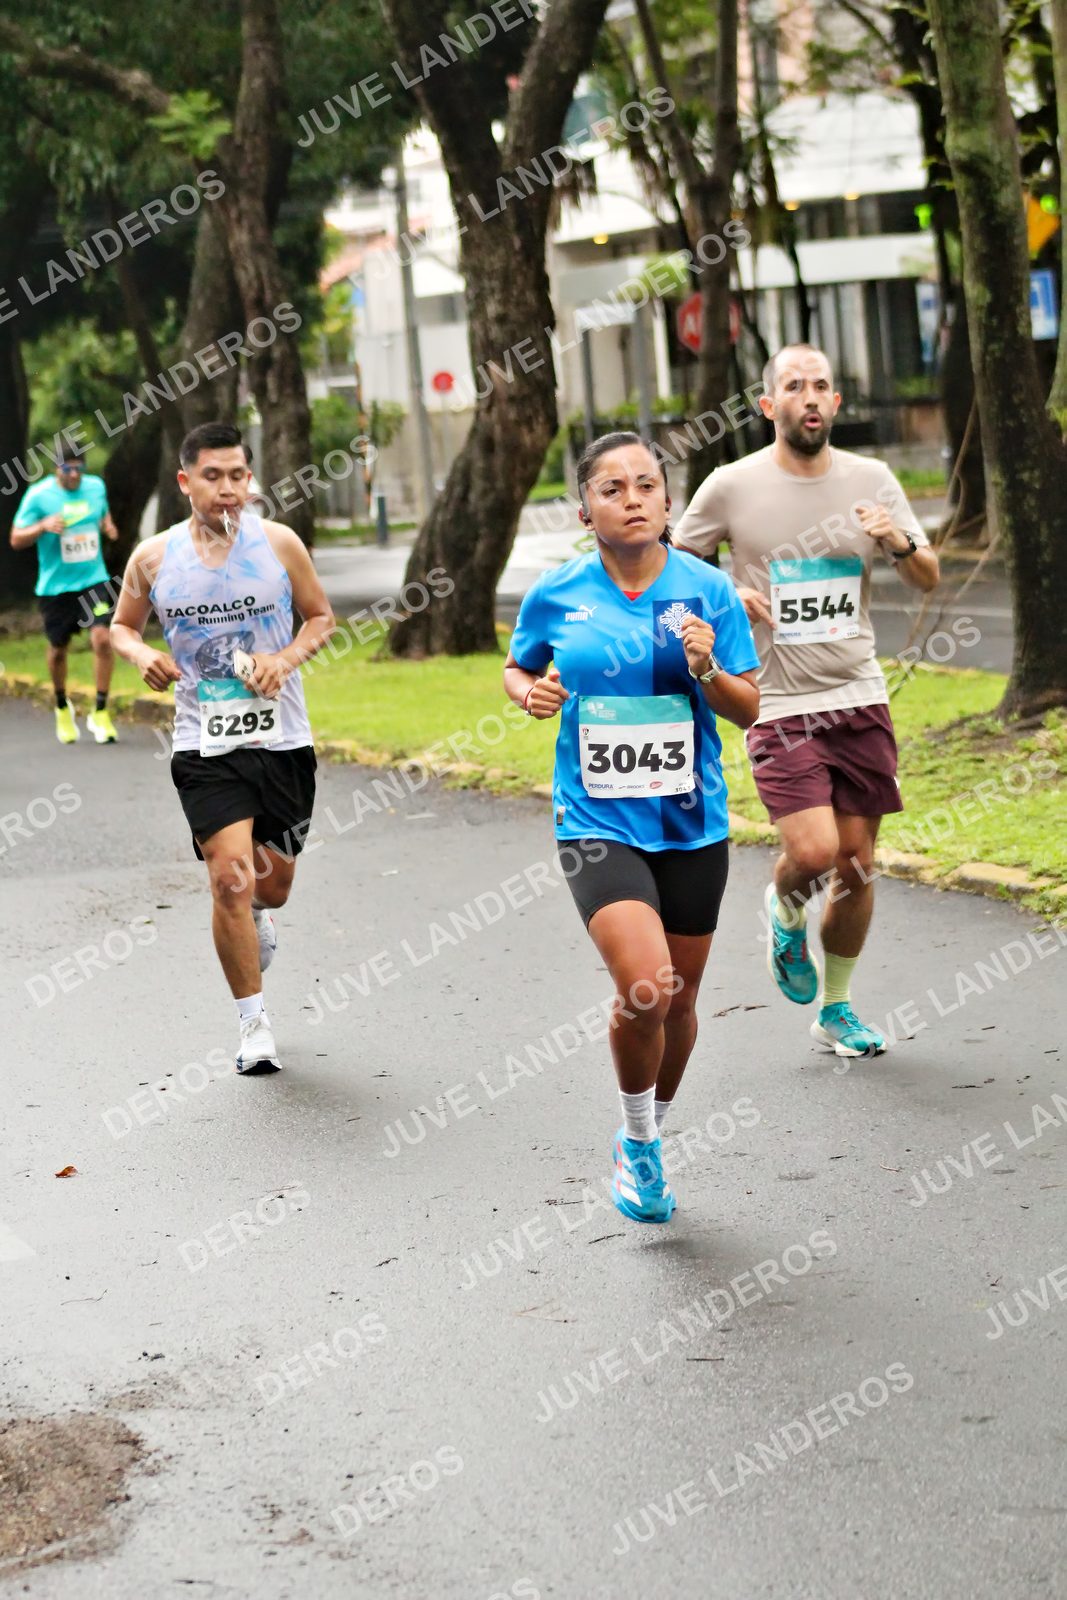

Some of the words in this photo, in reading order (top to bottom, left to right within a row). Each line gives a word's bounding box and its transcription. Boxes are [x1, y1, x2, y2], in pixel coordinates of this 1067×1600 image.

[166, 595, 256, 618] ZACOALCO
[198, 612, 245, 626] Running
[247, 603, 275, 617] Team
[779, 593, 855, 624] 5544
[207, 708, 275, 737] 6293
[587, 740, 686, 774] 3043
[588, 782, 614, 790] PERDURA
